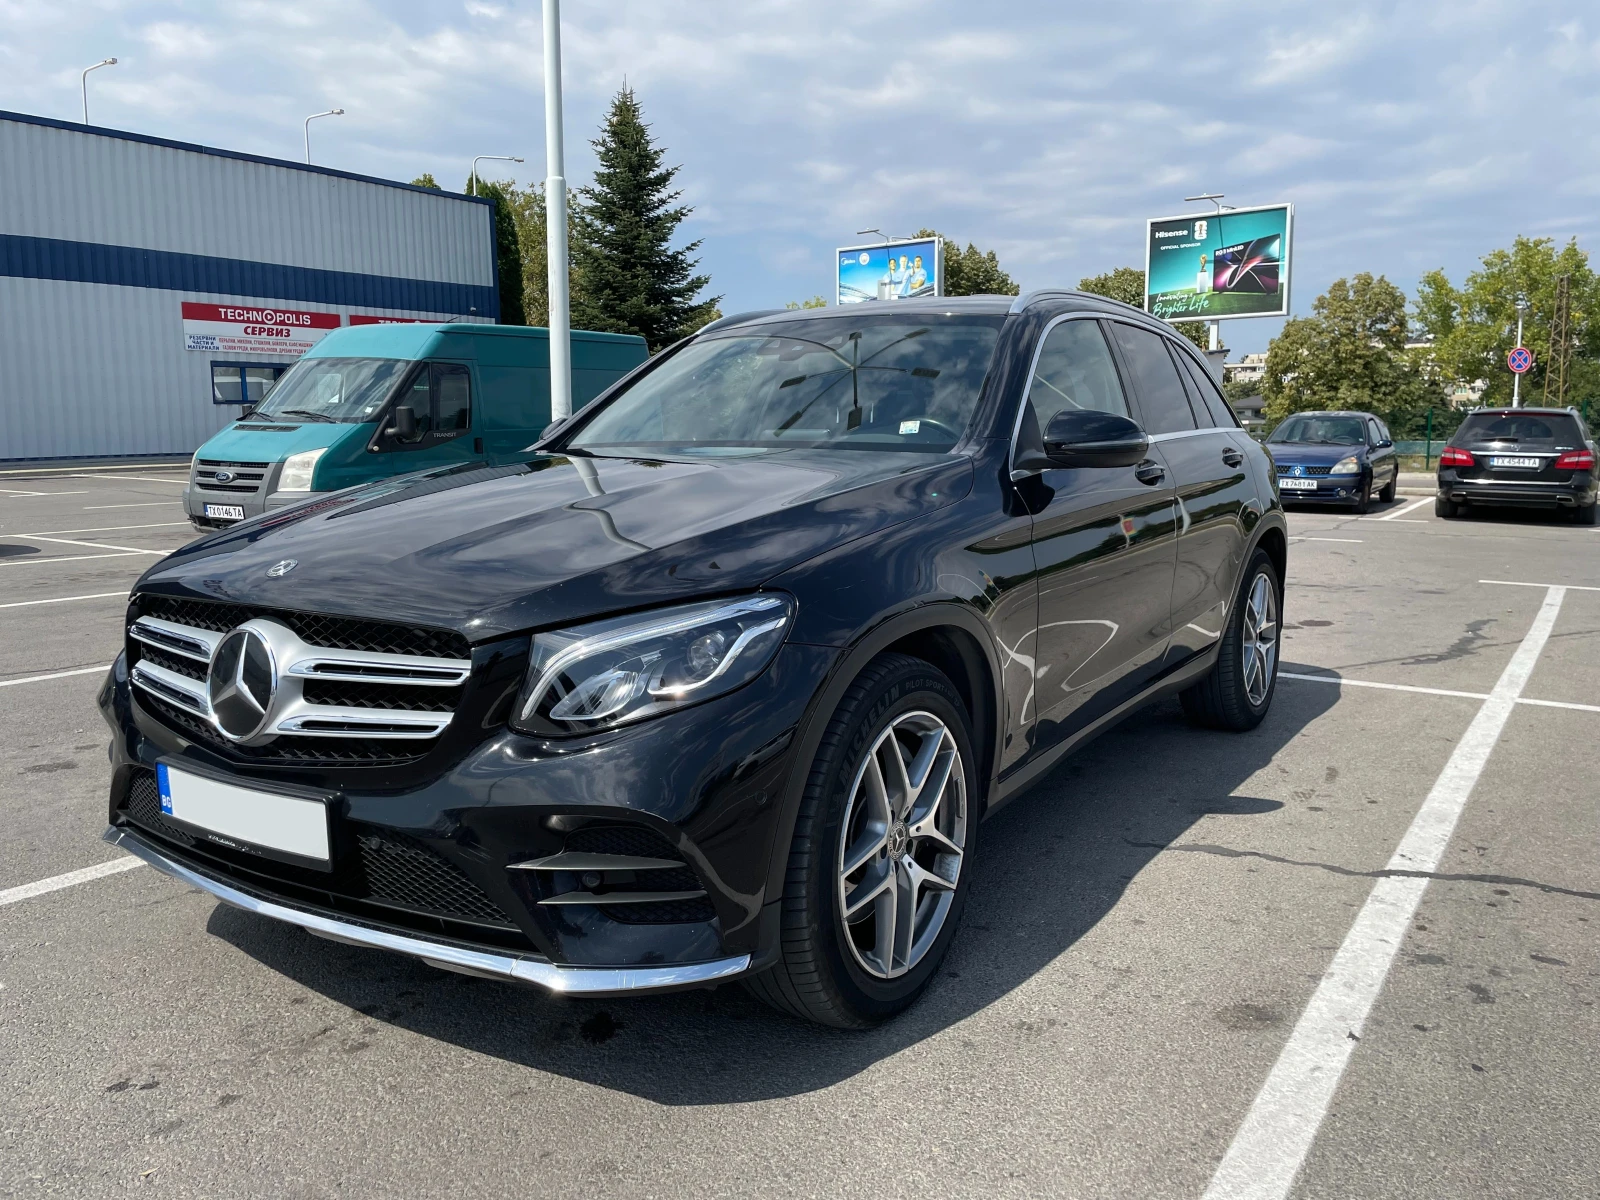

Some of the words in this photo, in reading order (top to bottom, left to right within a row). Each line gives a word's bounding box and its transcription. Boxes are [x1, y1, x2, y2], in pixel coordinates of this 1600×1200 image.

[1155, 229, 1189, 239] Hisense
[1156, 291, 1188, 302] Innovating
[1152, 301, 1188, 319] Brighter
[1188, 295, 1210, 313] Life
[218, 308, 311, 325] TECHNOPOLIS
[243, 325, 291, 338] СЕРВИЗ
[905, 678, 924, 691] PILOT
[925, 679, 945, 691] SPORT
[840, 683, 900, 786] MICHELIN
[161, 794, 172, 808] BG
